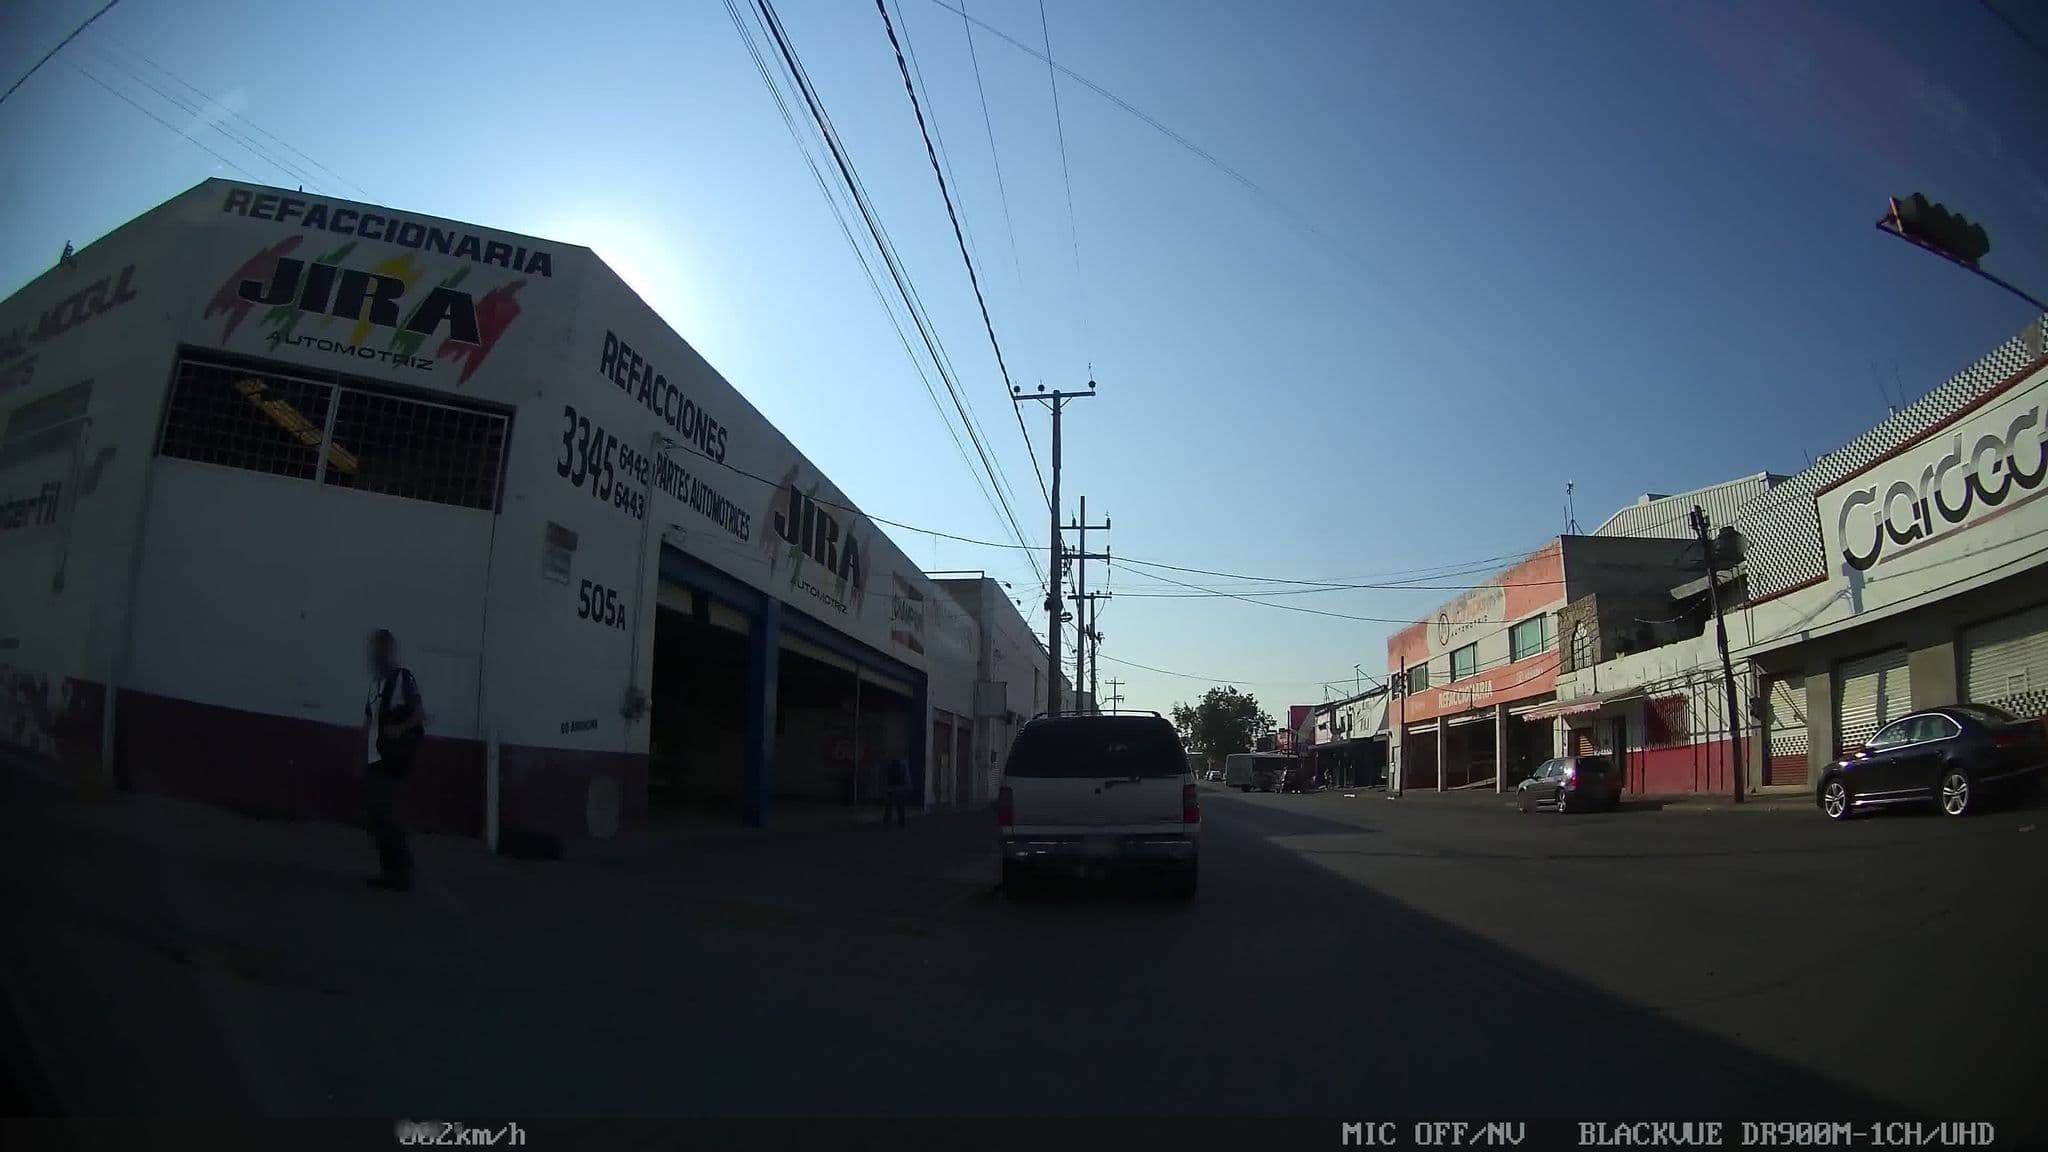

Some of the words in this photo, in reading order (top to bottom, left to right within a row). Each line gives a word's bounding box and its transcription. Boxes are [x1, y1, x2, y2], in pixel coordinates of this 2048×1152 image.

[224, 189, 552, 277] REFACCIONARIA
[238, 257, 481, 345] JIRA
[265, 331, 433, 371] AUTOMOTRIZ
[601, 329, 727, 464] REFACCIONES
[558, 405, 617, 501] 3345
[620, 444, 649, 485] 6442
[654, 451, 690, 503] PARTES
[689, 477, 750, 542] AUTOMOTRICES
[1838, 405, 2048, 571] Cardec
[614, 482, 644, 520] 6443
[774, 484, 860, 589] JIRA
[578, 579, 625, 630] 505A
